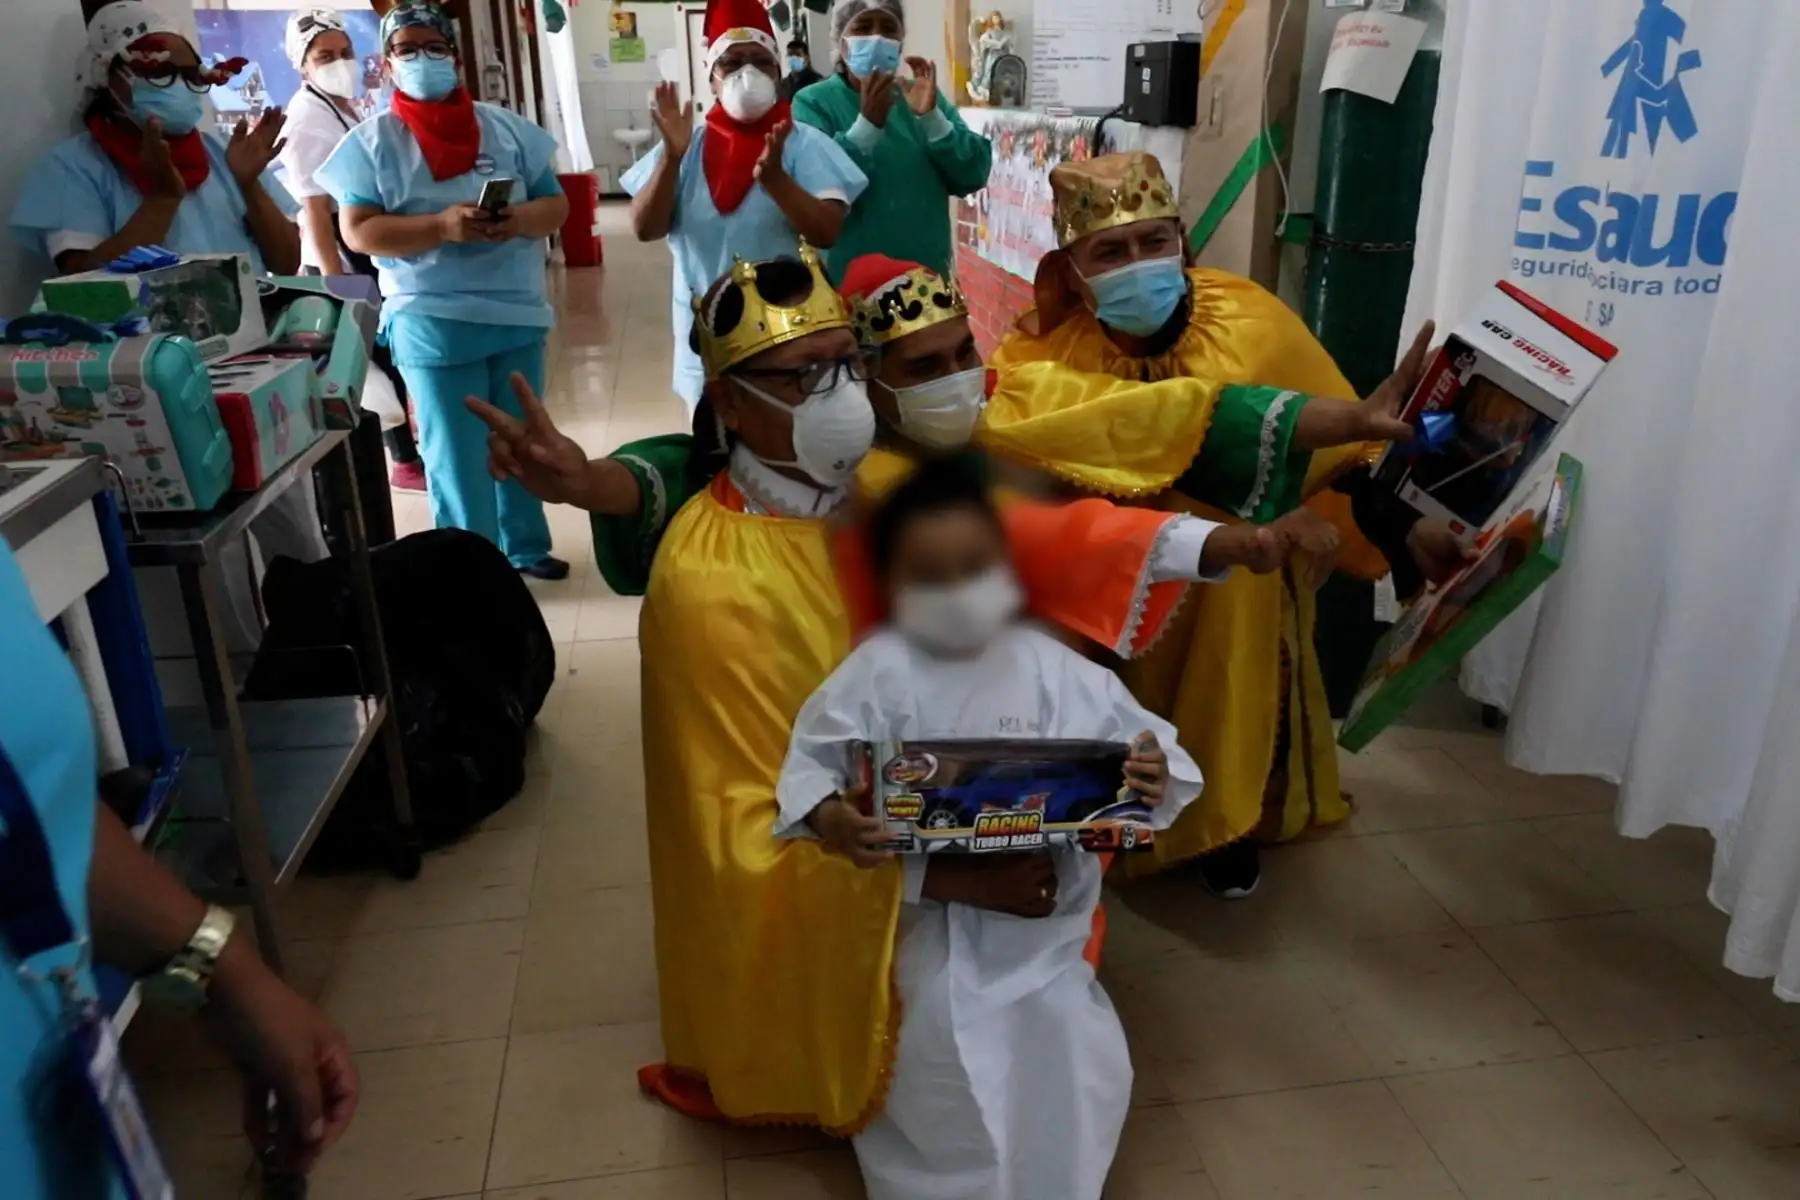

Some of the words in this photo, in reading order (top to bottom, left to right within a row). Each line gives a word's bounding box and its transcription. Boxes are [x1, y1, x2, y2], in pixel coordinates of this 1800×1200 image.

[1481, 319, 1512, 340] CAR
[1512, 339, 1571, 375] RACING
[978, 814, 1039, 835] RACING
[1010, 832, 1043, 847] RACER
